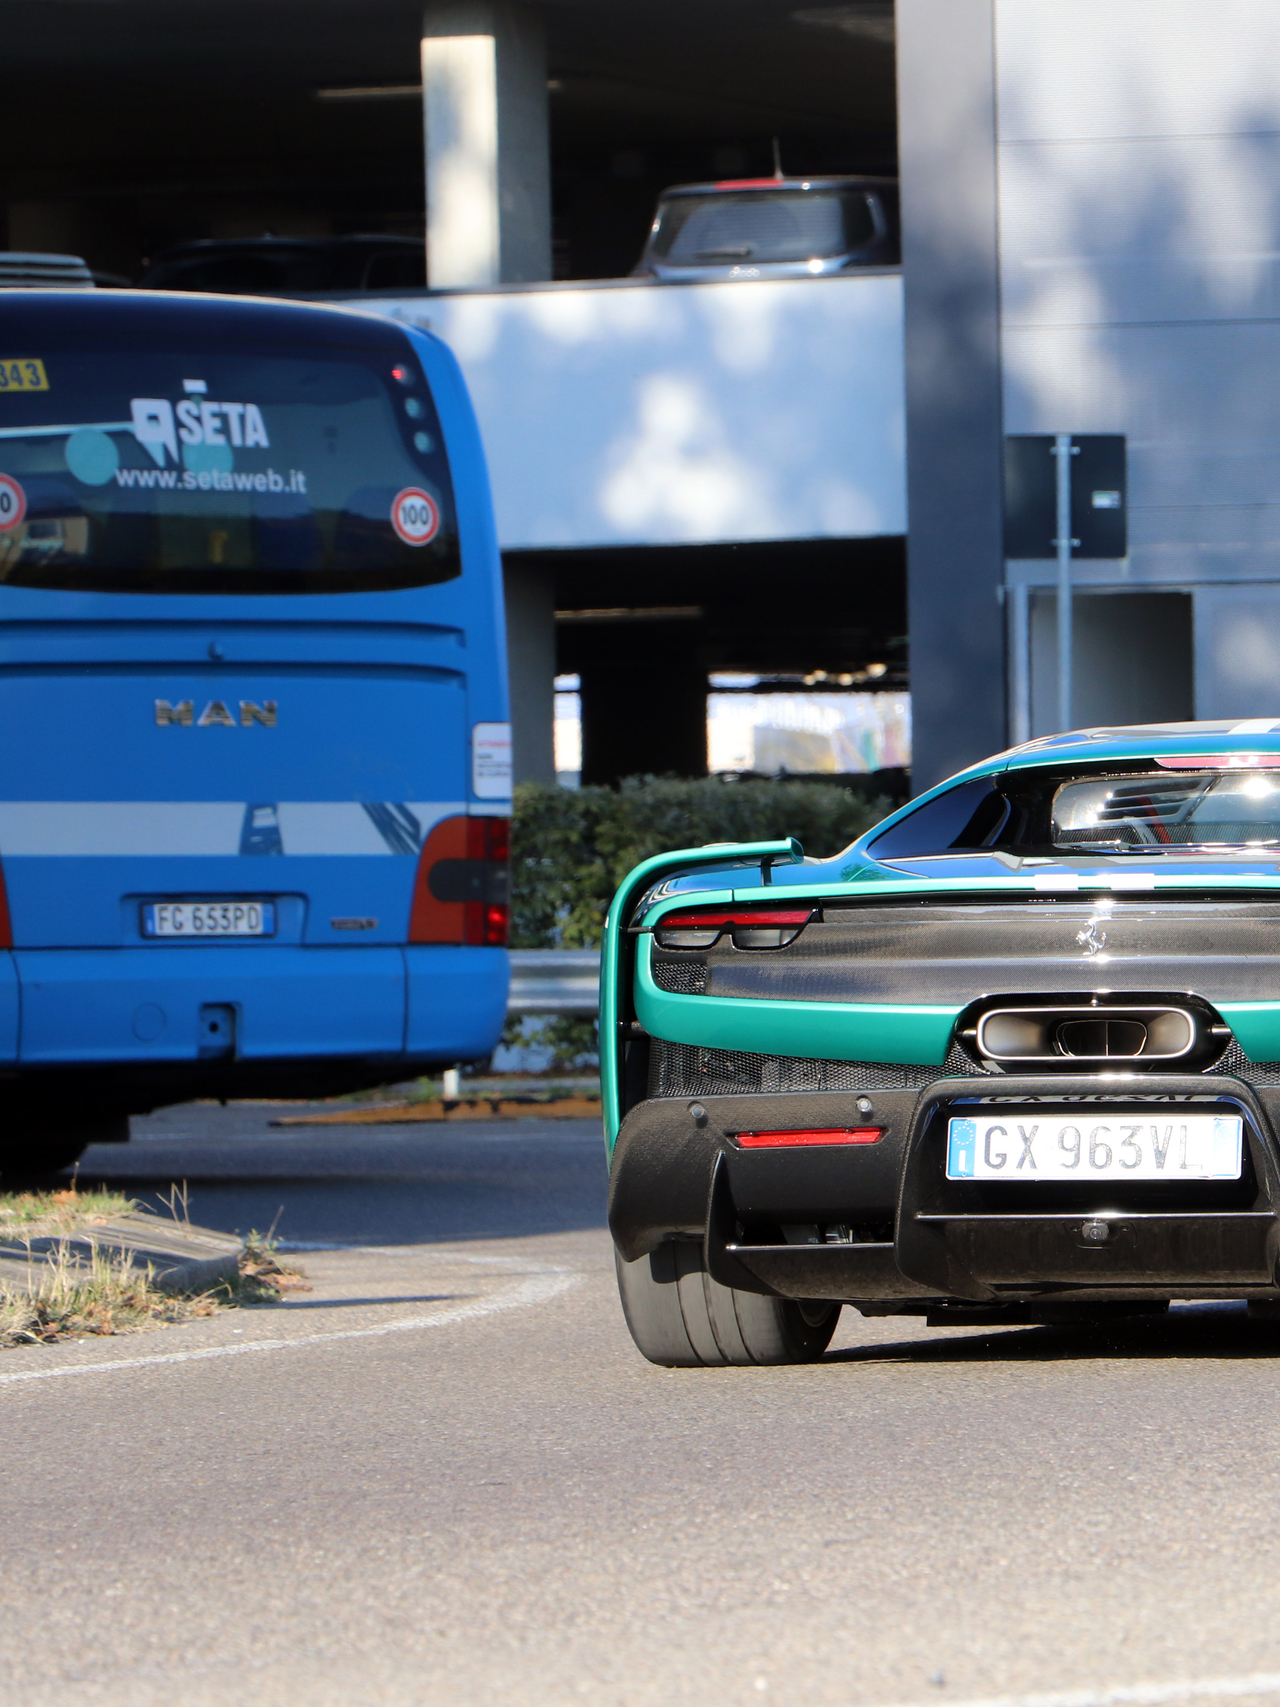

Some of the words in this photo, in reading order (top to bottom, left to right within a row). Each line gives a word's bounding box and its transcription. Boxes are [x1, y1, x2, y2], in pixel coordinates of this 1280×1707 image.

[176, 400, 270, 448] SETA
[115, 467, 307, 494] www.setaweb.it
[401, 504, 430, 526] 100
[155, 699, 277, 727] MAN
[158, 905, 184, 931] FG
[984, 1125, 1039, 1170] GX
[1057, 1125, 1203, 1170] 963VL
